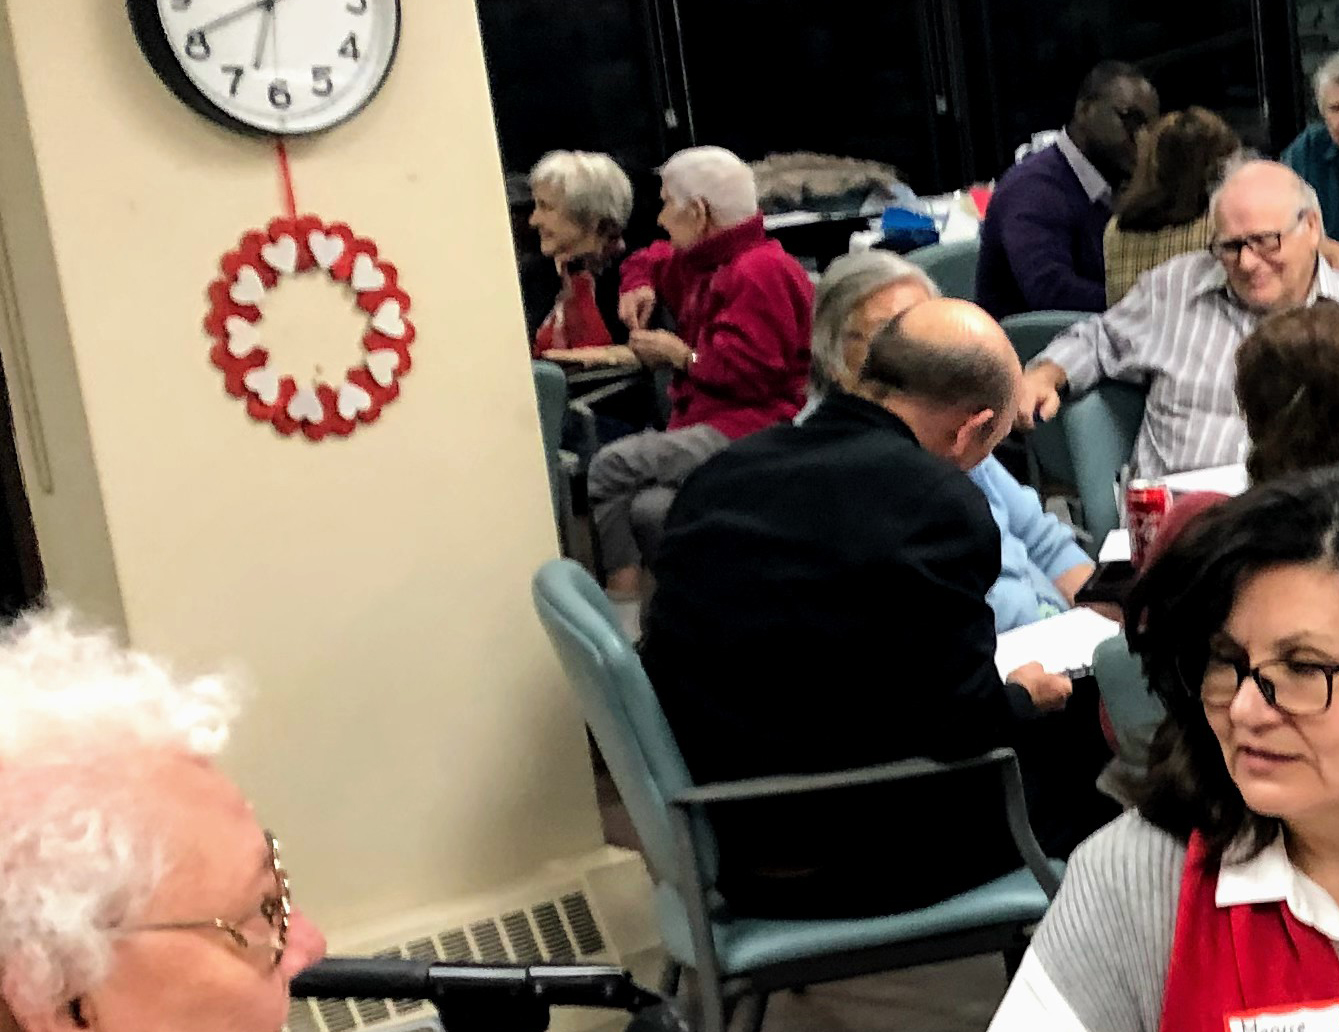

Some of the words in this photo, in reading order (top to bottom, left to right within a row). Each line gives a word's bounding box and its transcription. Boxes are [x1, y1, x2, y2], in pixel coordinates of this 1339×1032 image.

[338, 31, 360, 61] 4
[221, 65, 244, 97] 7
[267, 78, 291, 108] 6
[312, 65, 333, 96] 5
